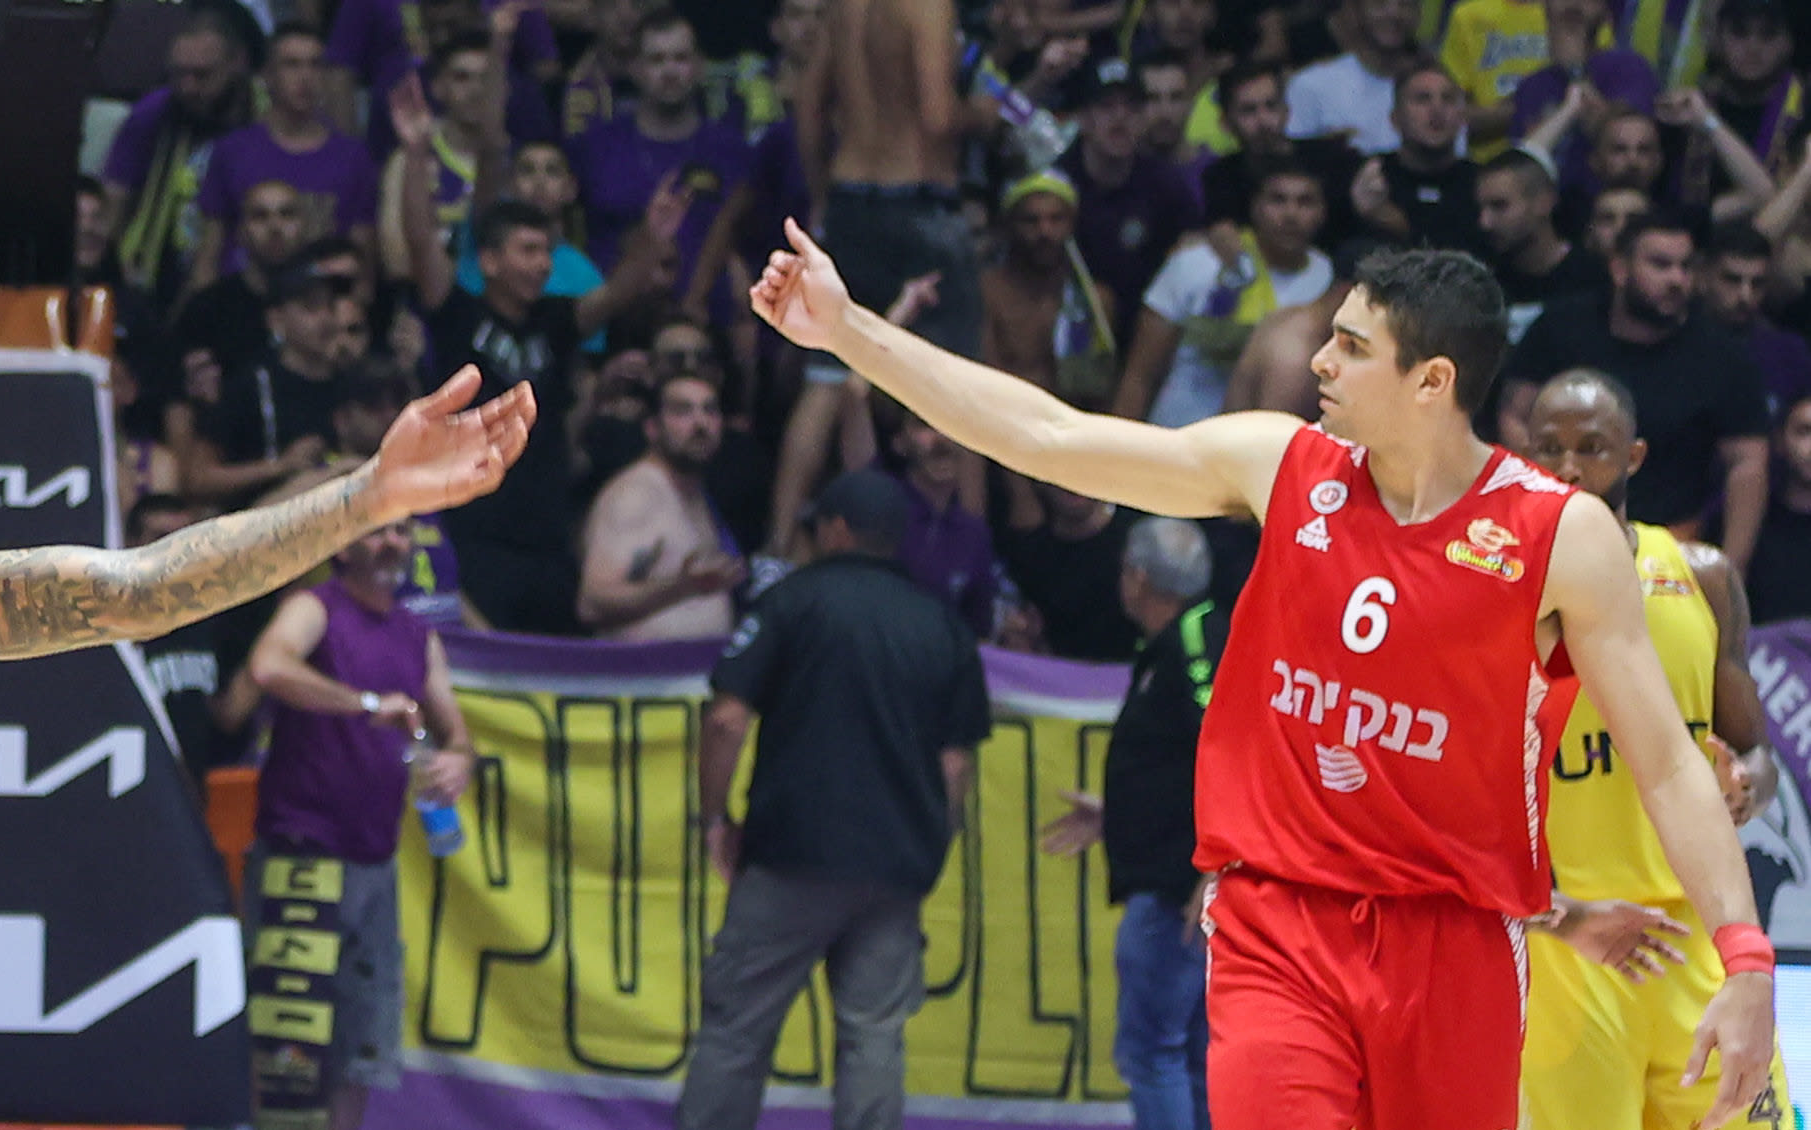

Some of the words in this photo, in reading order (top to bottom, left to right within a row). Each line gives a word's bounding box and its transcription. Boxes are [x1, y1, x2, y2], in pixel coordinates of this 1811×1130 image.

[1341, 576, 1396, 654] 6
[1270, 658, 1341, 725] יהב
[1344, 689, 1448, 762] בנק
